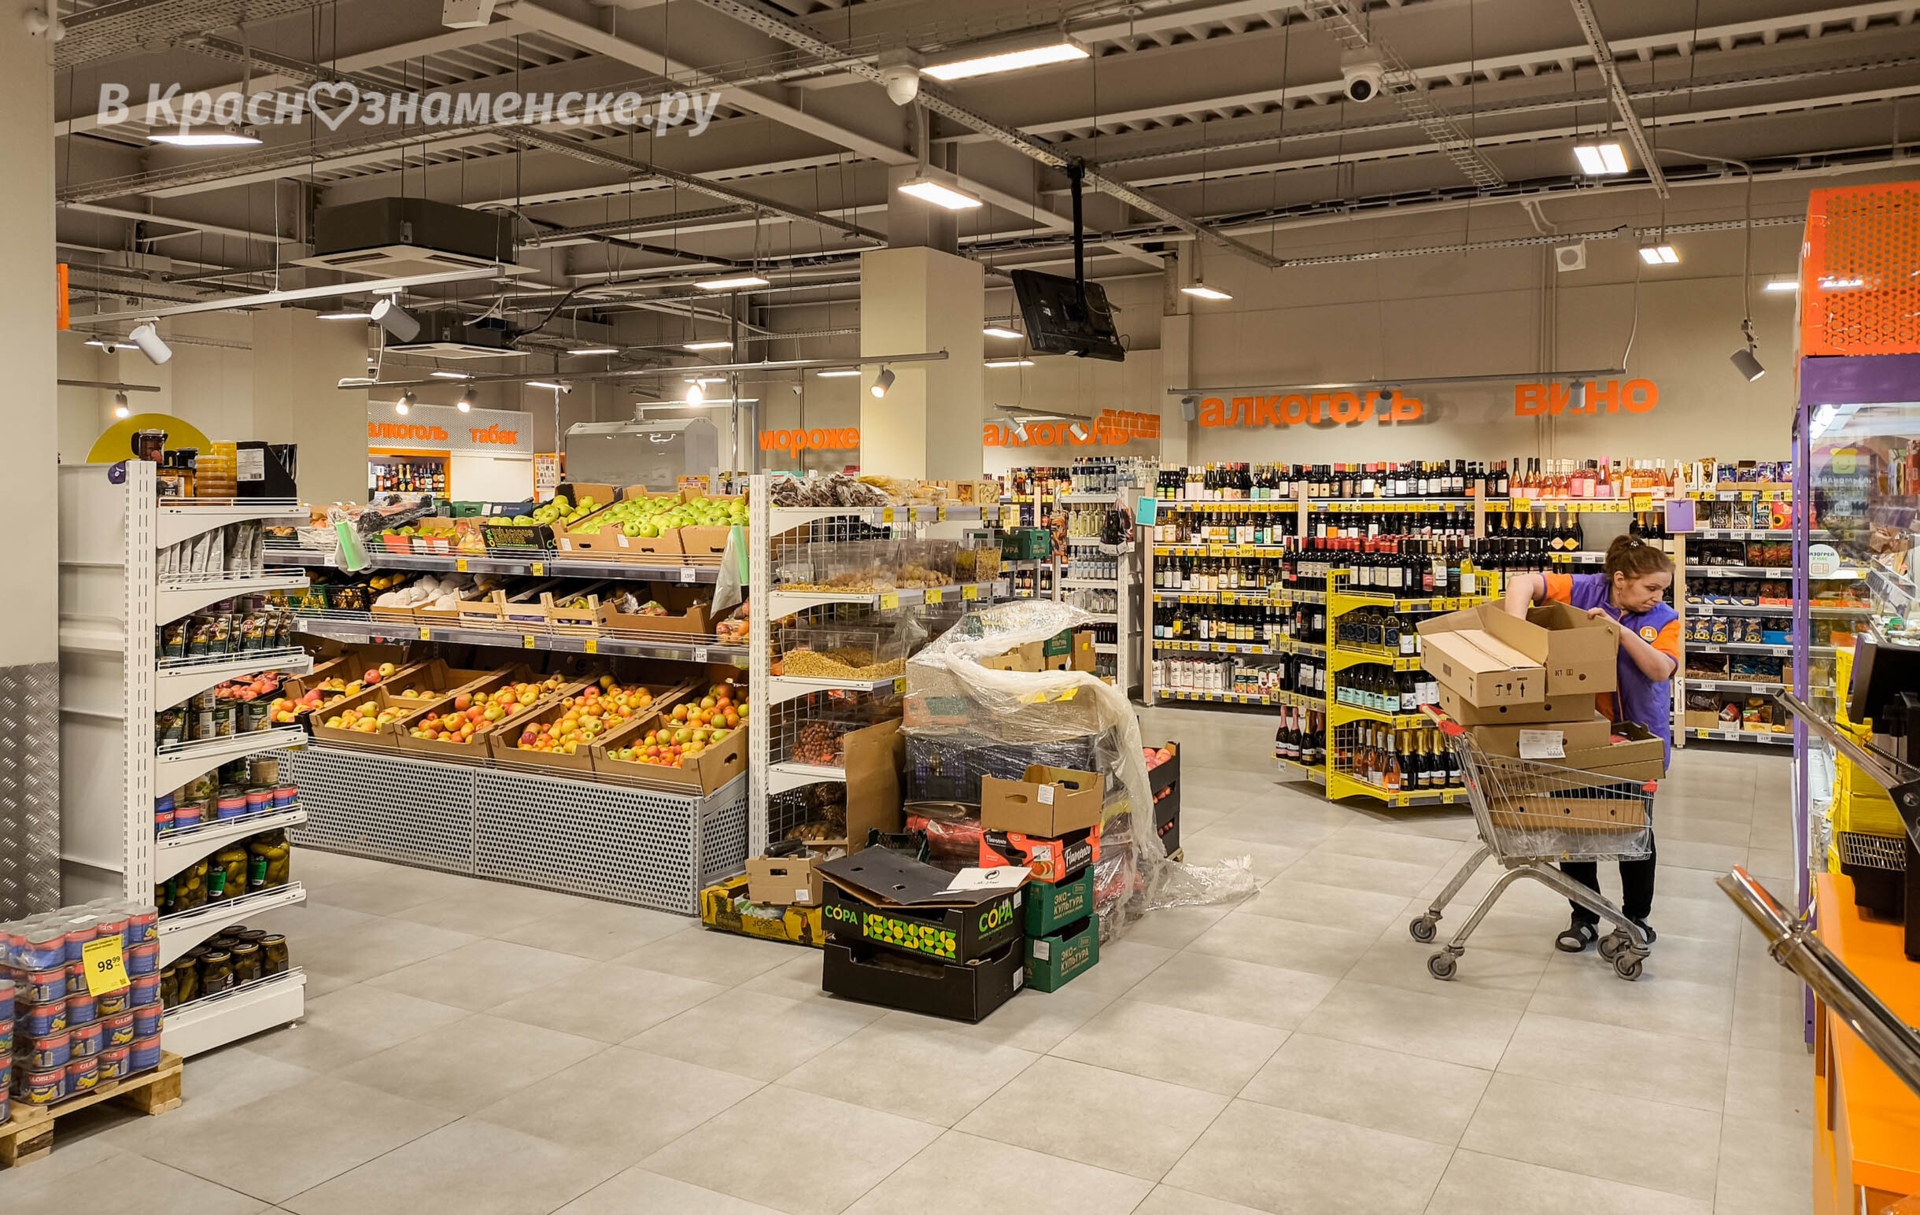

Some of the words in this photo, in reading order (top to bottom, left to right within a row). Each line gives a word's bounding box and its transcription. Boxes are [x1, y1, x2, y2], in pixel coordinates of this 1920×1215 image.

[1514, 378, 1659, 416] вино
[1200, 389, 1423, 428] алкоголь
[368, 421, 449, 441] алкоголь
[469, 424, 518, 445] табак
[1054, 895, 1083, 915] КУЛЬТУРА
